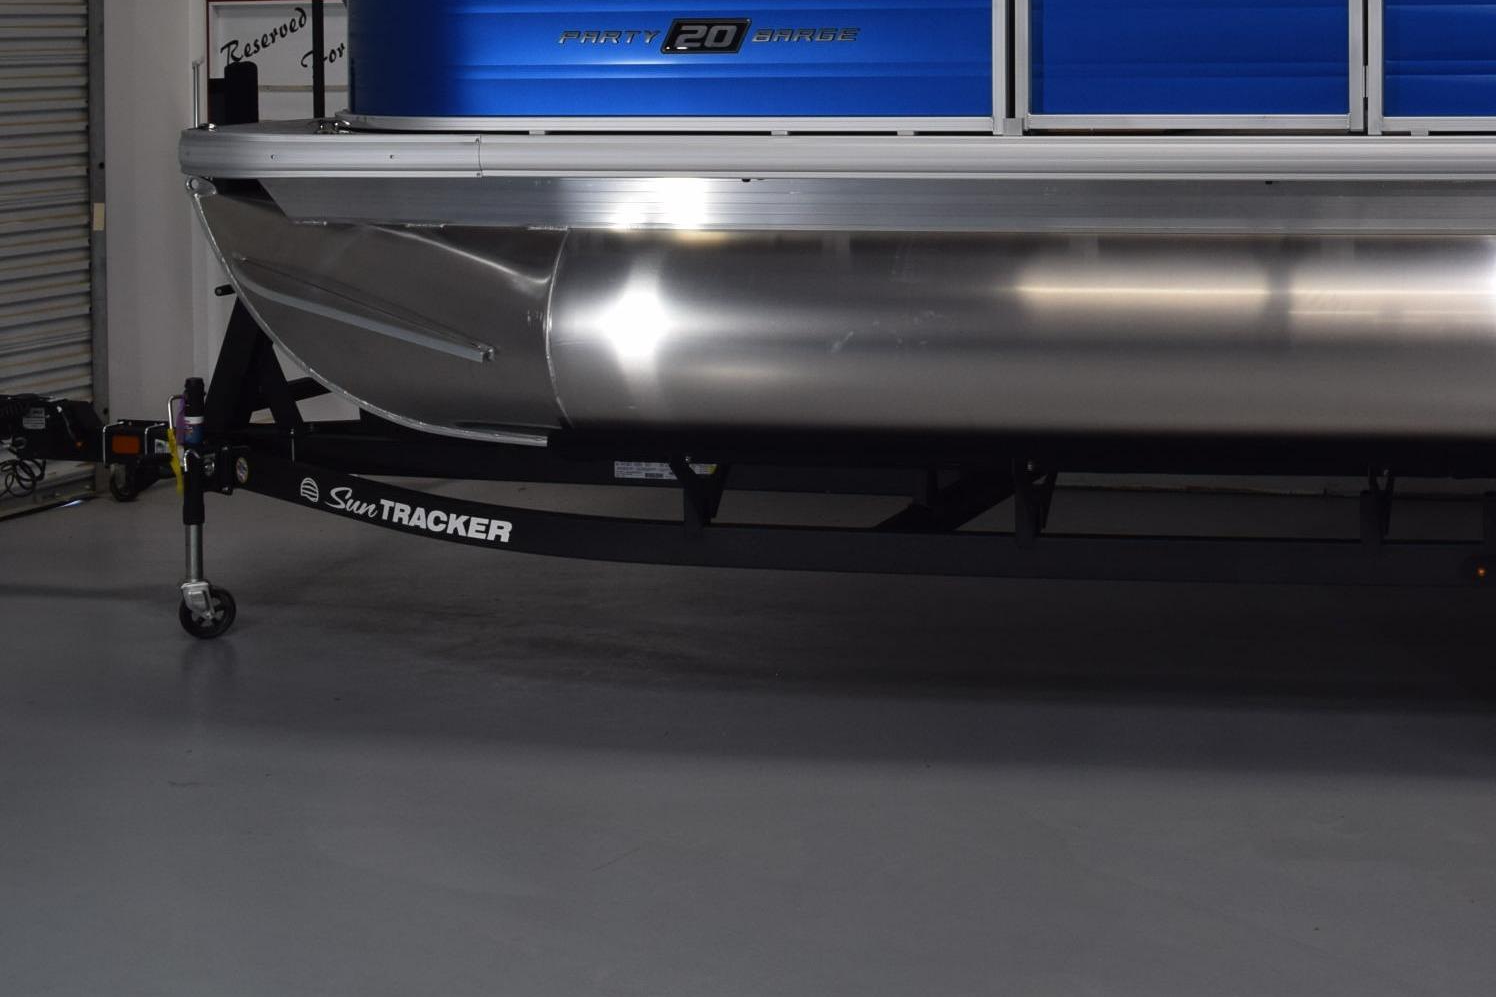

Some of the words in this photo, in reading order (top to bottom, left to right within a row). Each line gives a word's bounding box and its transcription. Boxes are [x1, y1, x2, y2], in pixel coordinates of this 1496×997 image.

[220, 7, 307, 66] Reserved
[559, 30, 660, 44] PARTY
[674, 25, 738, 48] 20
[752, 27, 858, 43] BARGE
[325, 486, 378, 519] Sun
[380, 498, 513, 543] TRACKER
